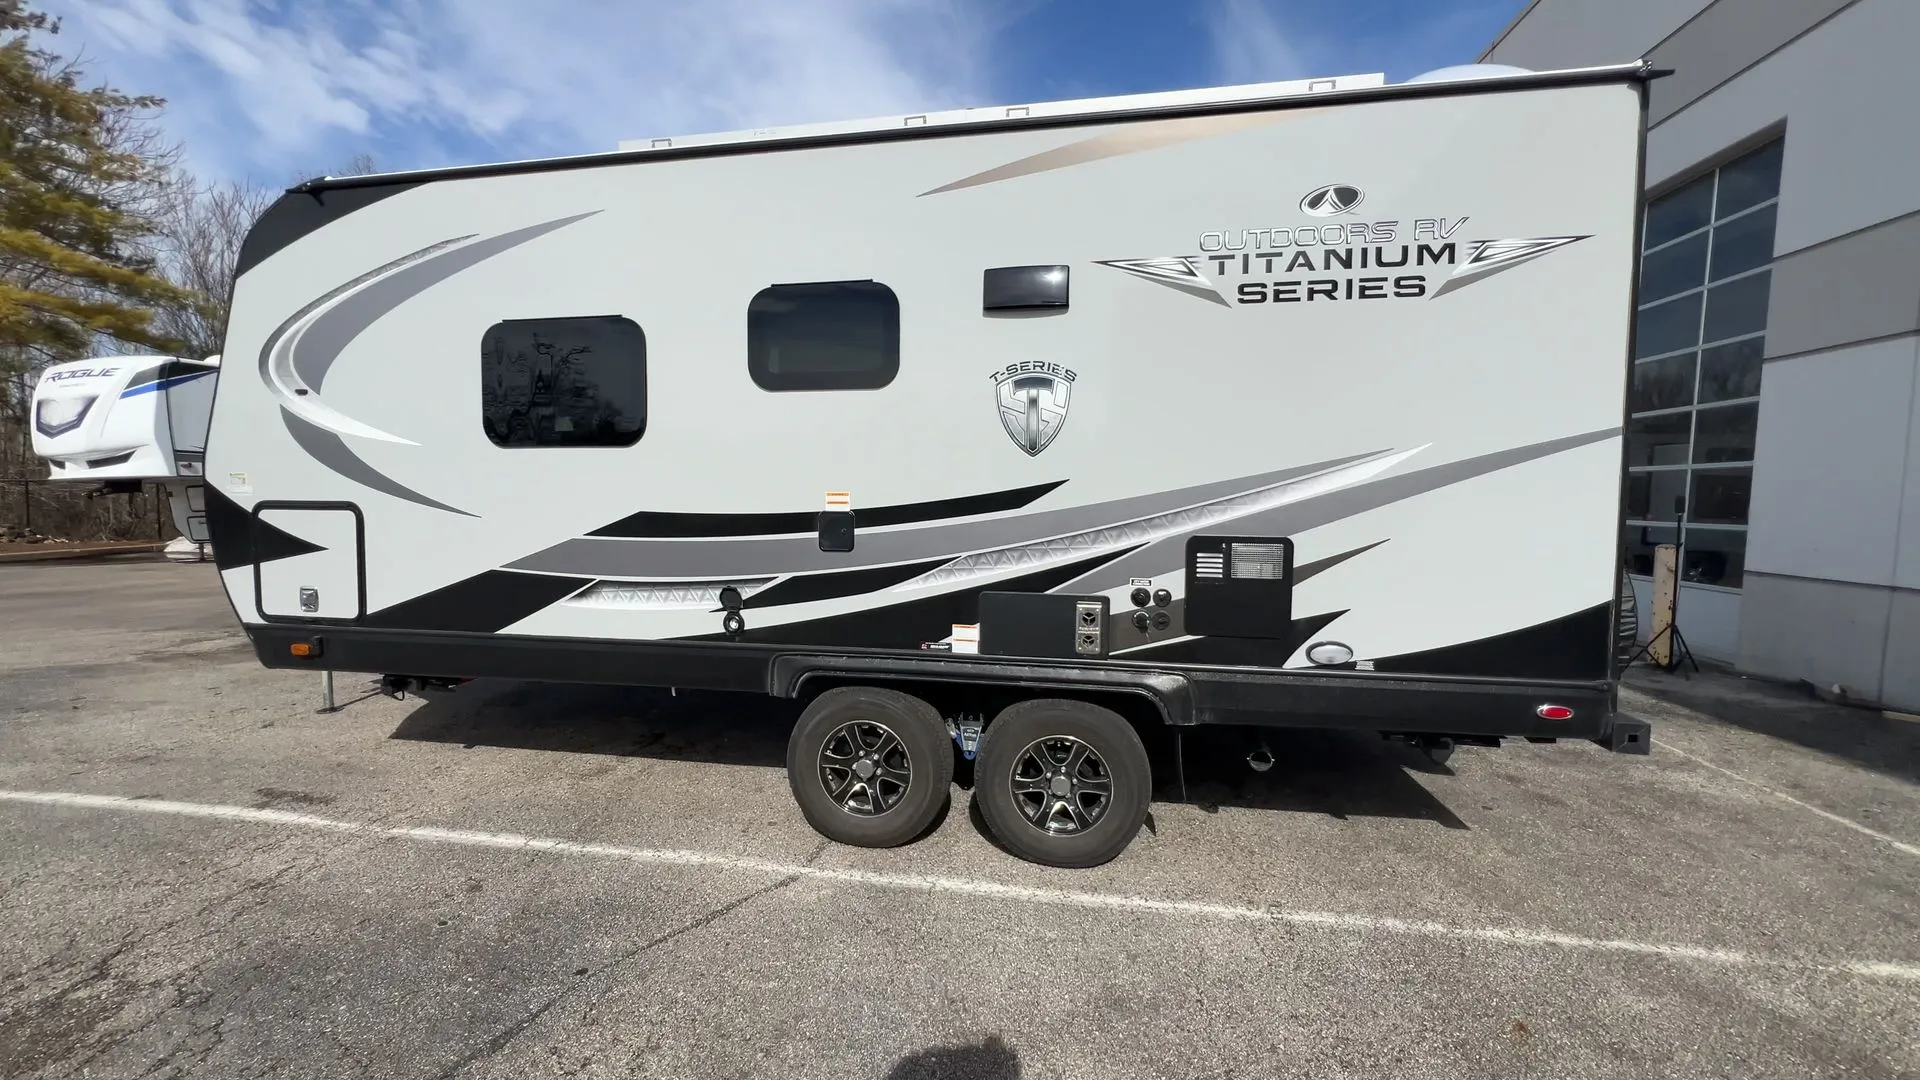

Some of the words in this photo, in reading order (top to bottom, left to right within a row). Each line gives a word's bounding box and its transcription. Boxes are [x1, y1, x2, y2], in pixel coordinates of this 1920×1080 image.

[1199, 220, 1399, 251] OUTDOORS
[1413, 216, 1470, 241] RV
[1208, 242, 1456, 276] TITANIUM
[1237, 275, 1427, 304] SERIES
[44, 367, 122, 384] ROGUE
[989, 360, 1078, 383] T-SERIES
